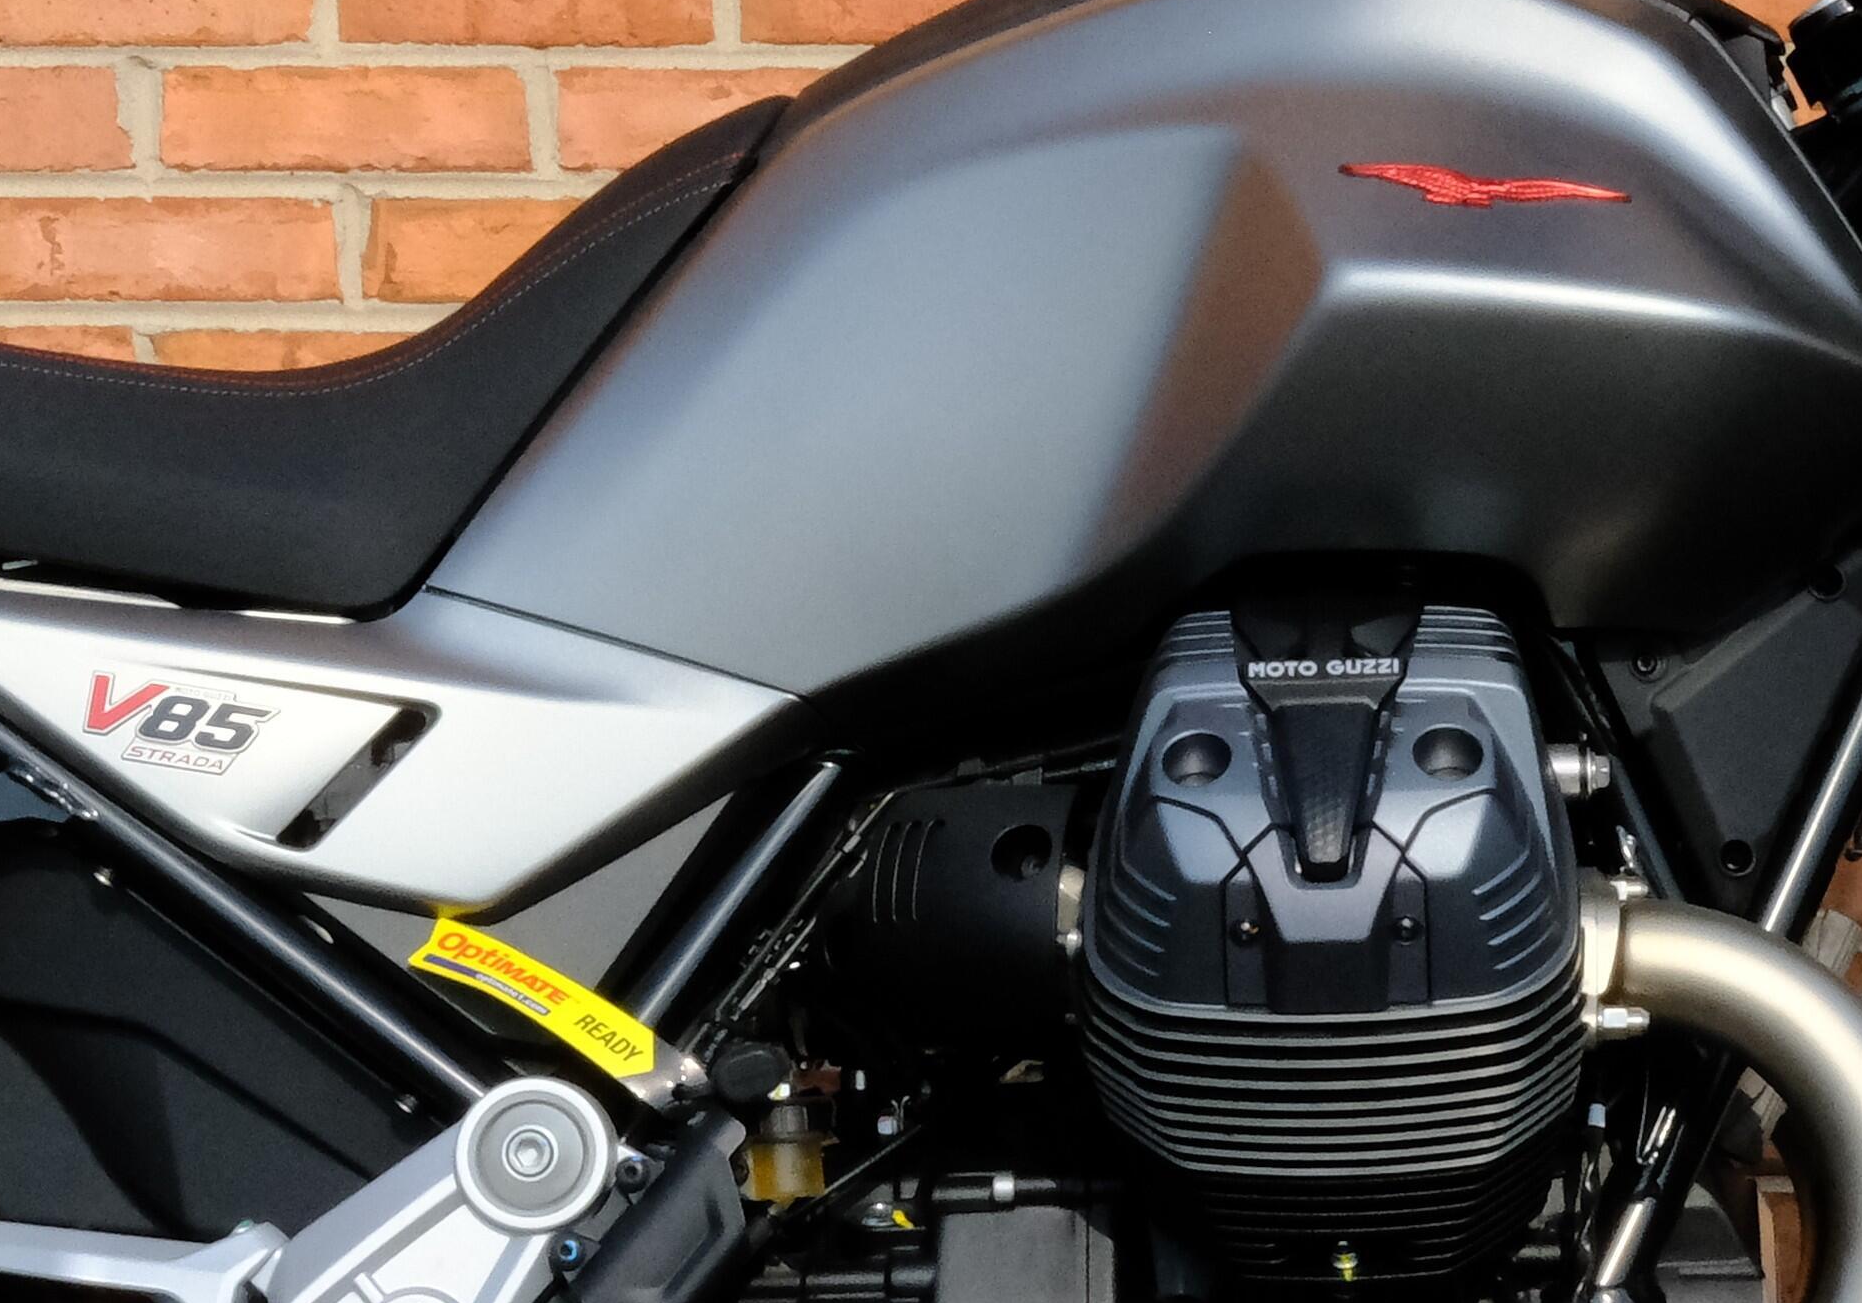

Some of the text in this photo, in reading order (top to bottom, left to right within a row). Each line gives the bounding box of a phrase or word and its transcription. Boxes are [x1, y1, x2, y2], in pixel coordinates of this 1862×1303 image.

[1248, 657, 1400, 678] MOTO GUZZI
[86, 674, 273, 750] V85
[128, 746, 223, 771] STRADA
[437, 932, 570, 1005] OptiMATE
[574, 1014, 644, 1062] READY
